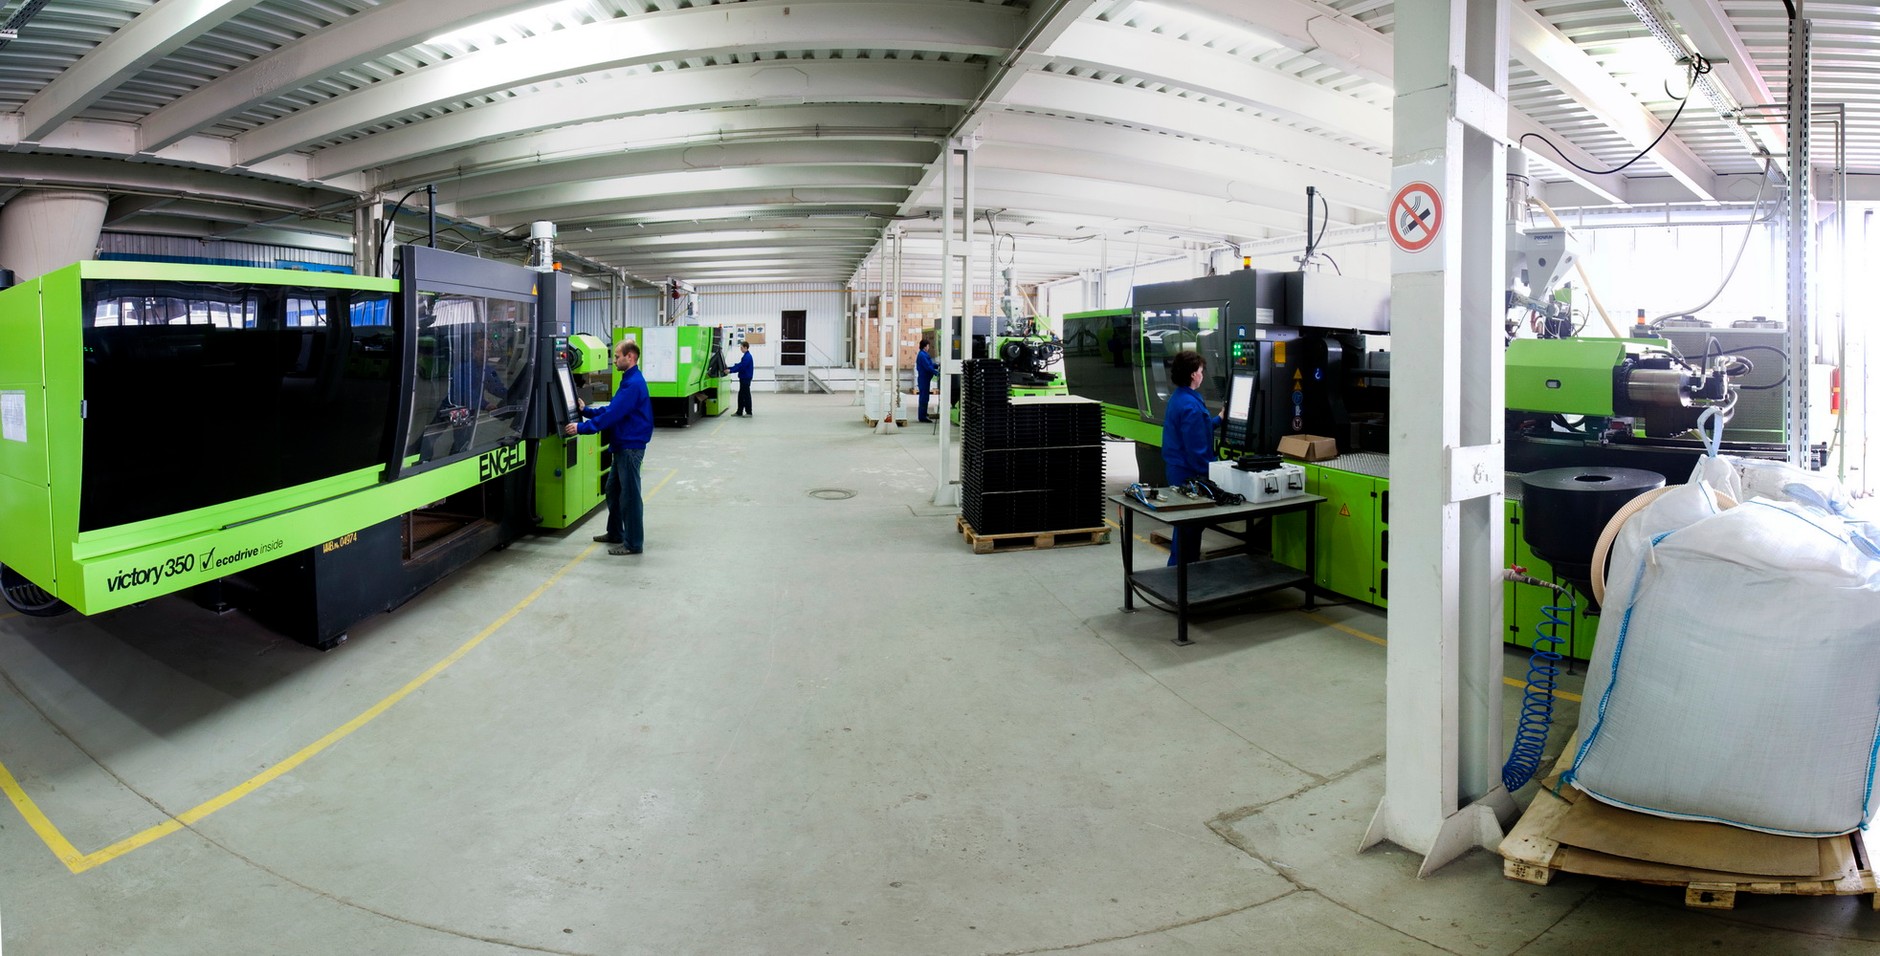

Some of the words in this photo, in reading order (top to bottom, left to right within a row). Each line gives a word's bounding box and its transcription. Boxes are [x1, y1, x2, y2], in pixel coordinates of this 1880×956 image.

[479, 441, 525, 482] ENGEL
[107, 564, 164, 592] victory
[164, 553, 195, 577] 350
[215, 547, 259, 568] ecodrive
[260, 539, 284, 554] inside
